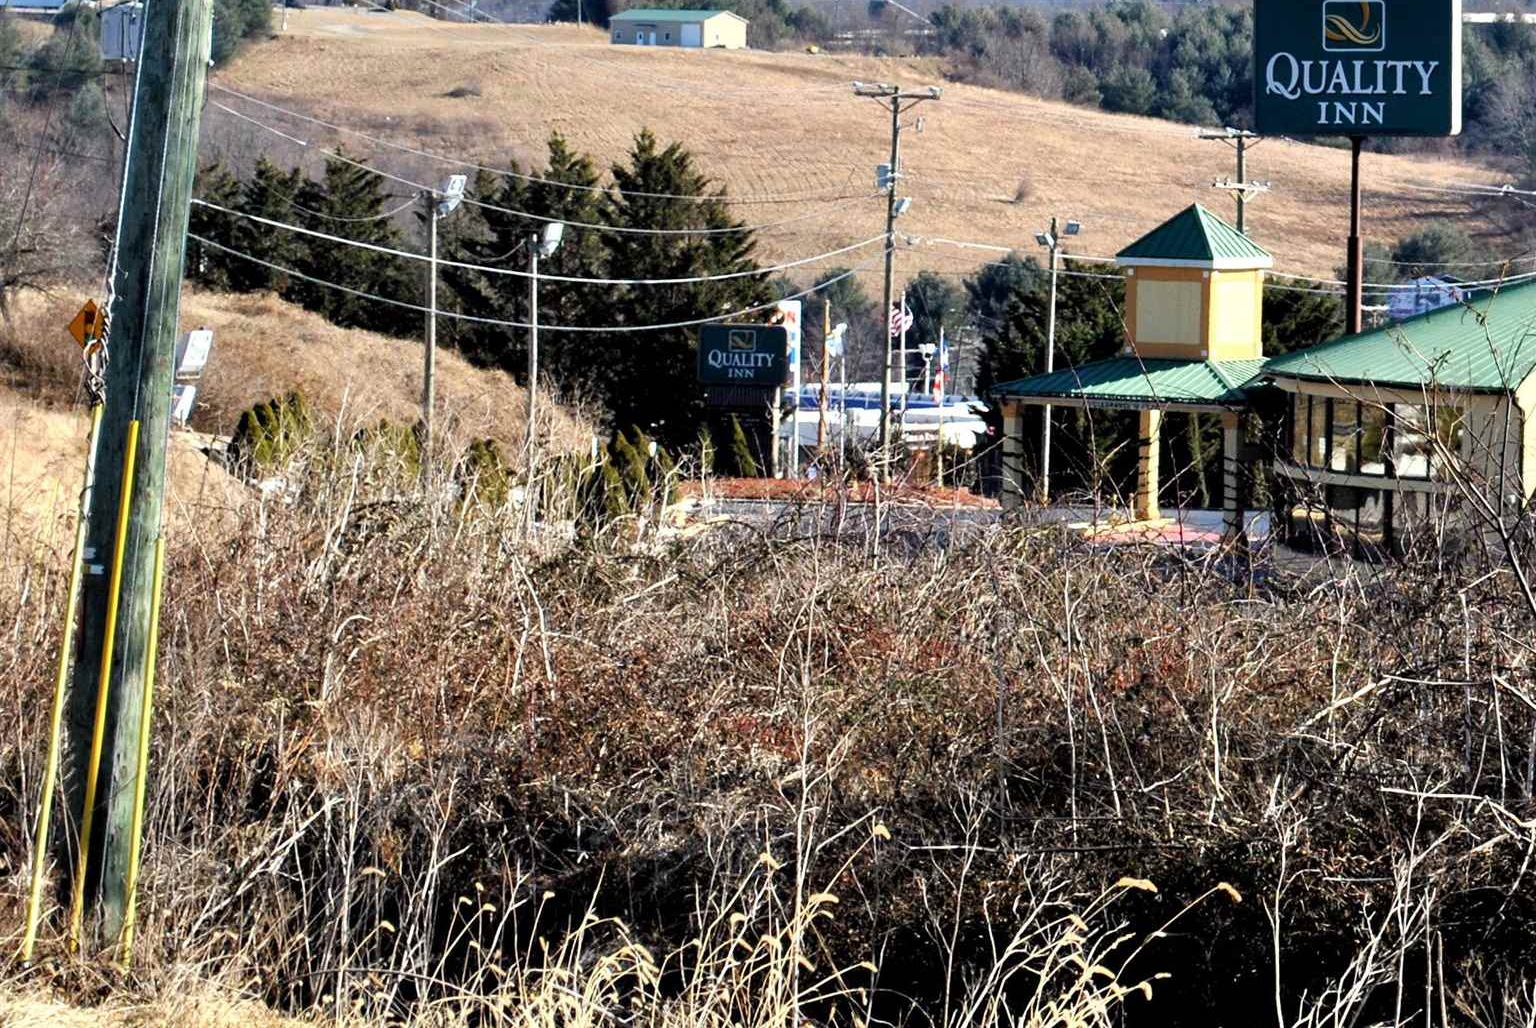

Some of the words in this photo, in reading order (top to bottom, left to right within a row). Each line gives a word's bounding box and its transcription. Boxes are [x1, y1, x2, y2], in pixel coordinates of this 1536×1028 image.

[1266, 52, 1439, 100] QUALITY
[1317, 102, 1385, 124] INN
[708, 349, 775, 368] QUALITY
[728, 368, 754, 379] INN
